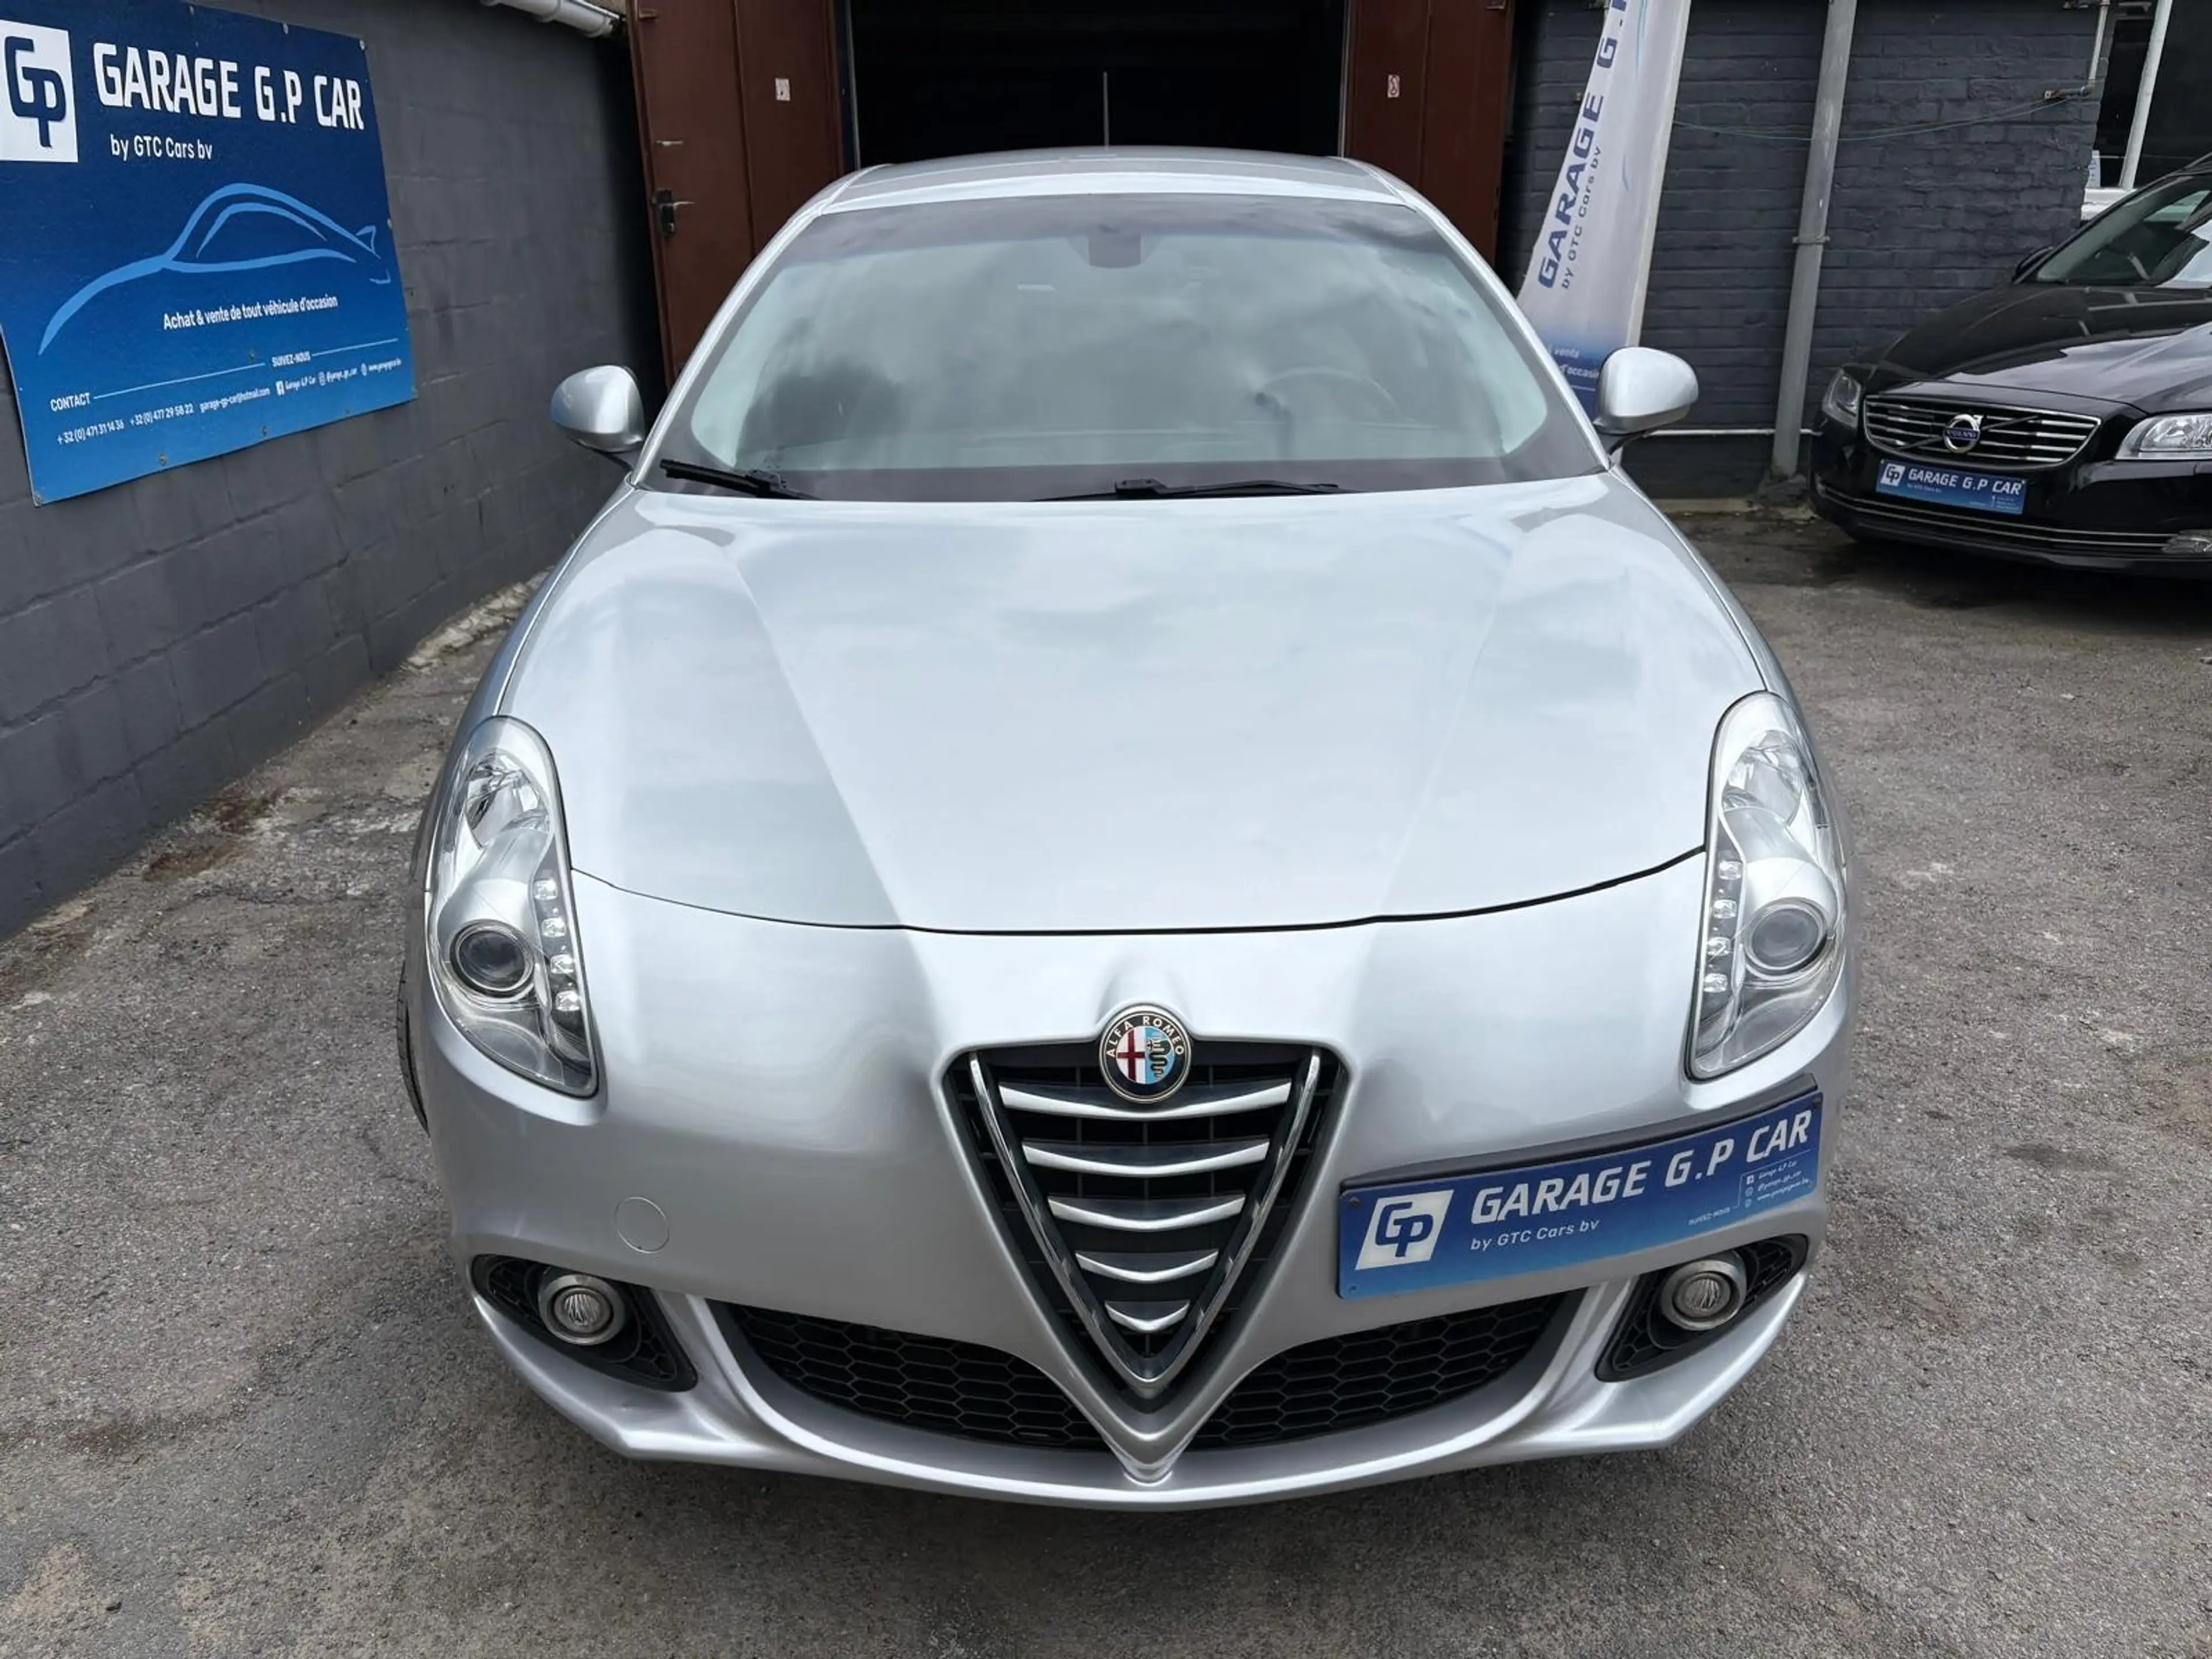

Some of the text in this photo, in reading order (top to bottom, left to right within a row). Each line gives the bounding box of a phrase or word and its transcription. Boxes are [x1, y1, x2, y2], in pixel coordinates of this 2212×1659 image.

[93, 43, 365, 130] GARAGE G.P CAR
[110, 134, 213, 161] by GTC Cars bv
[1538, 92, 1604, 289] GARAGE
[1561, 146, 1601, 289] by GTC Cars bv
[164, 293, 338, 330] Achat & vente de tout véhicule d'occasion
[50, 392, 90, 412] CONTACT
[1908, 468, 2021, 495] GARAGE G.P CAR
[1107, 1016, 1184, 1058] ALFA ROMEO
[1471, 1109, 1812, 1225] GARAGE G.P CAR
[1471, 1218, 1600, 1251] by GTC Cars bv
